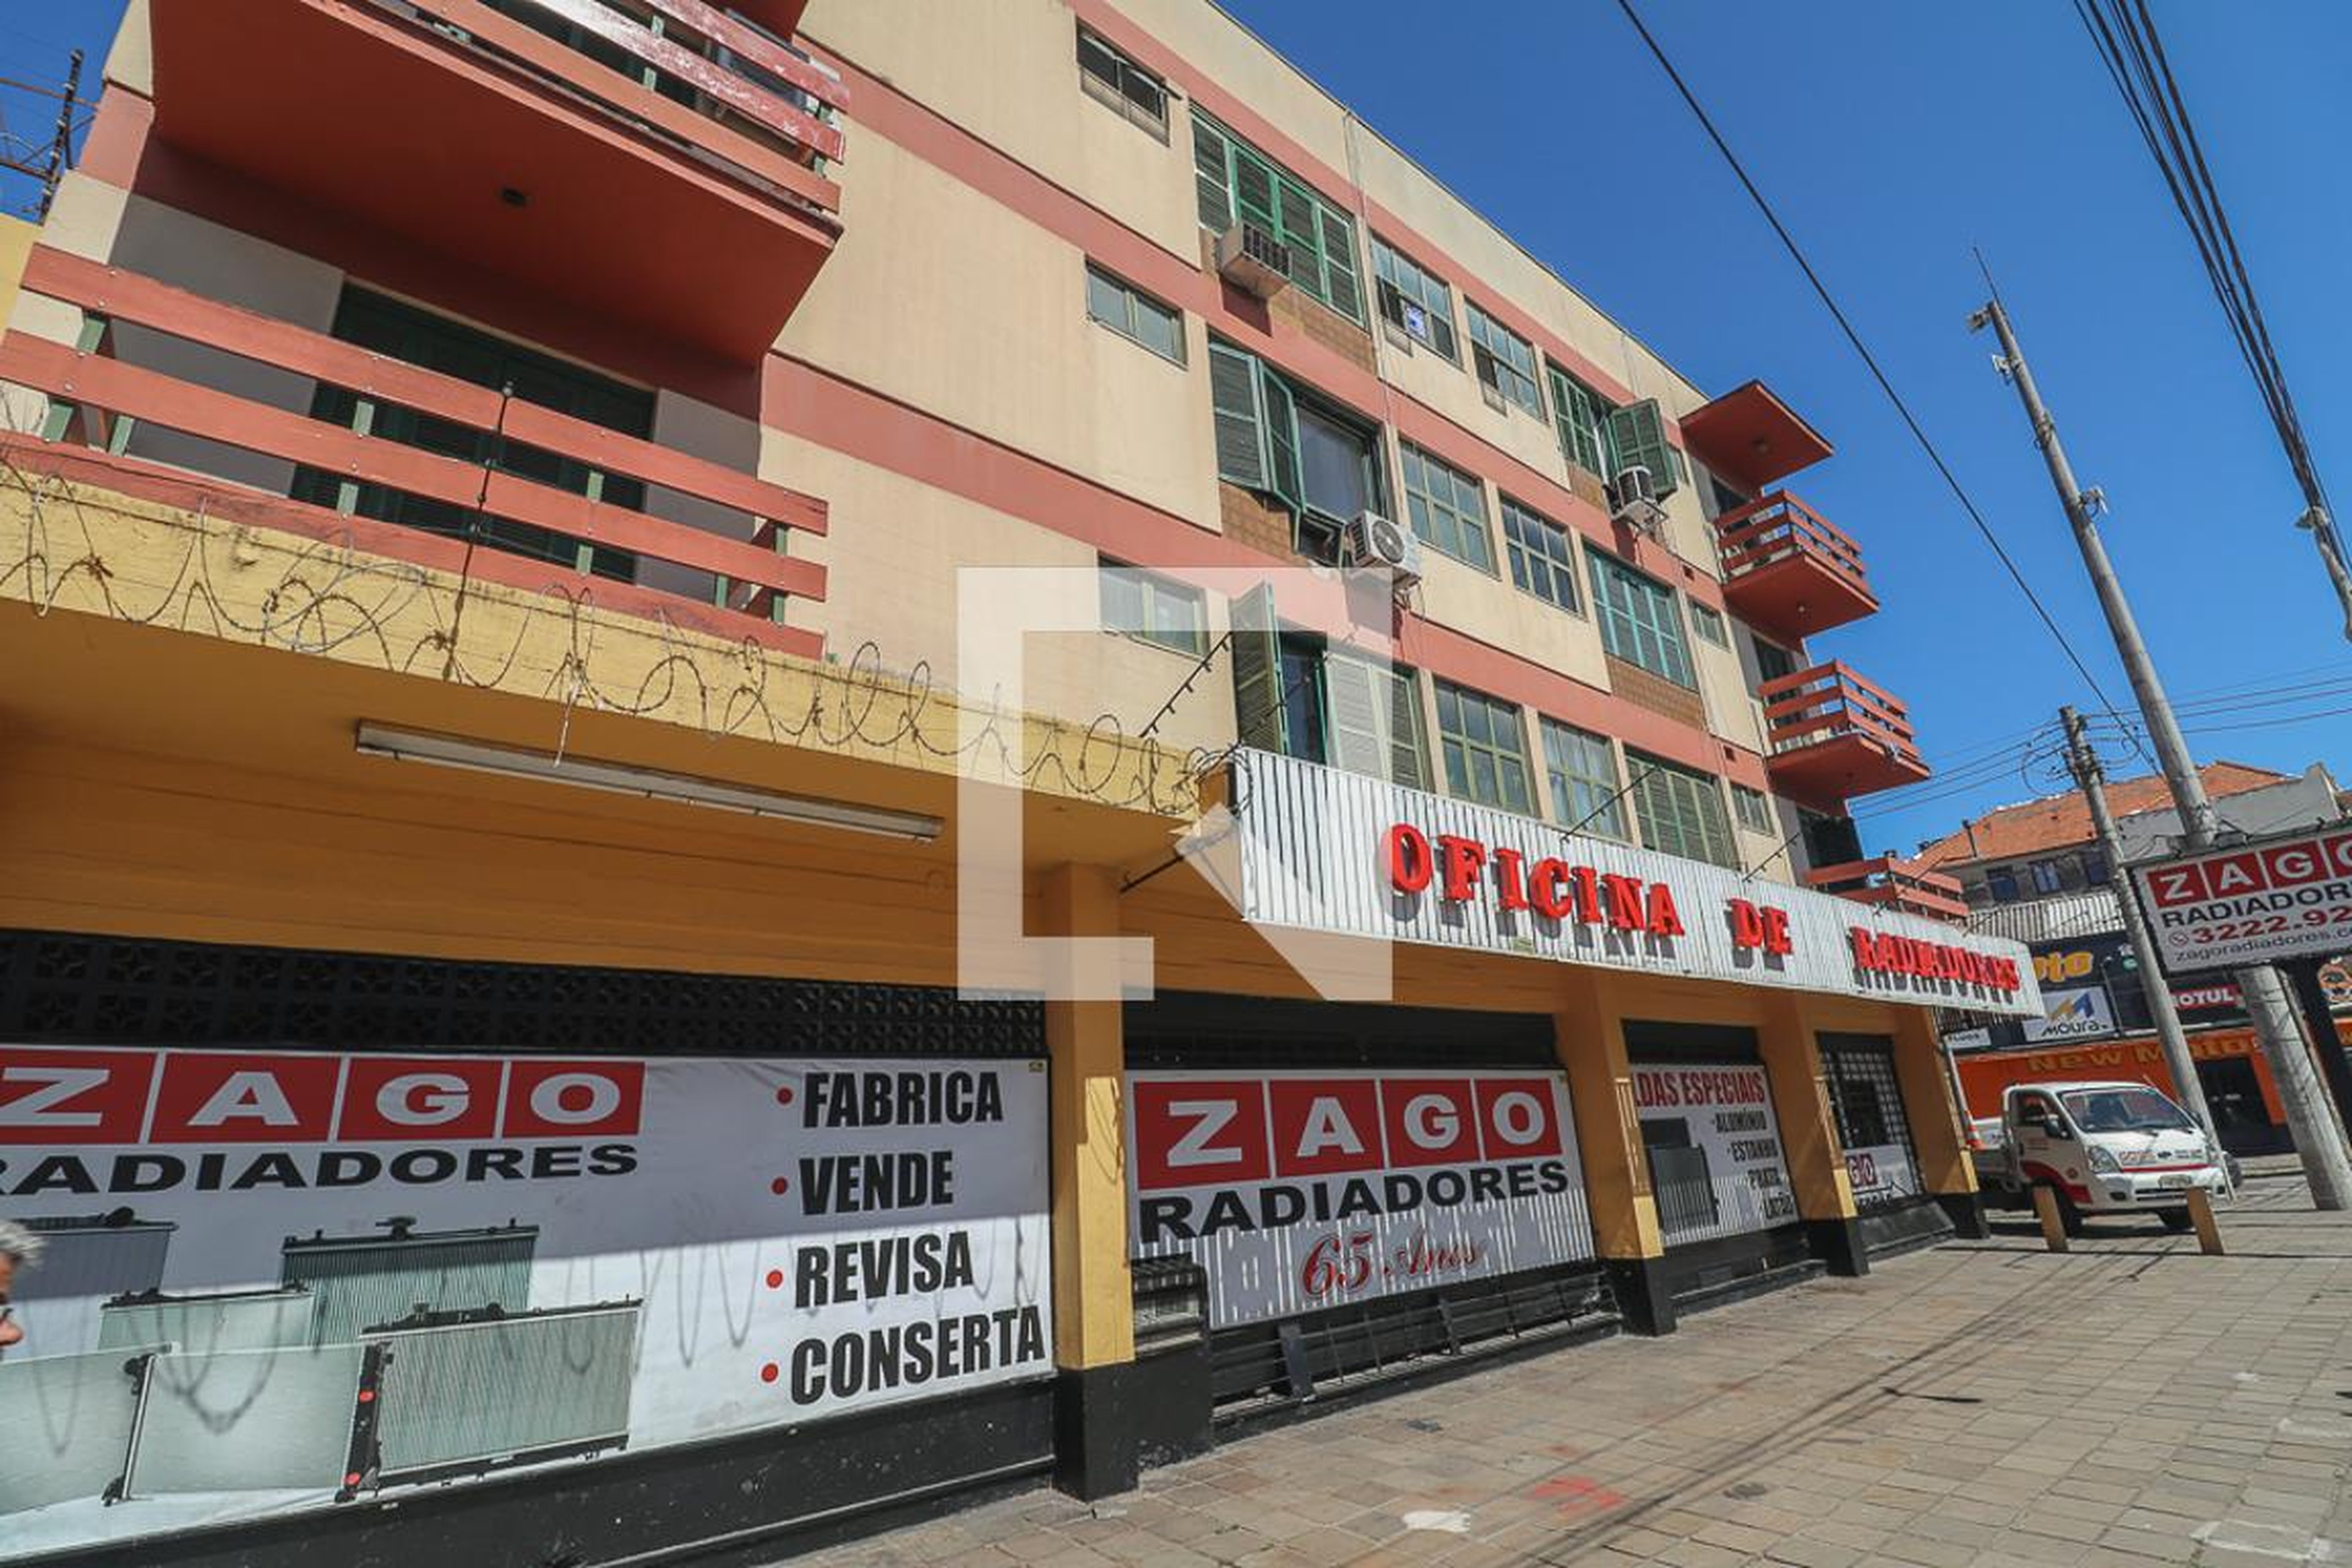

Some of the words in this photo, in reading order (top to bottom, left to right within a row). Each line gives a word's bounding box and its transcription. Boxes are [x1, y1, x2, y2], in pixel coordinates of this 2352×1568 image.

[1380, 823, 1686, 937] OFICINA
[1729, 897, 1792, 955] DE
[2163, 882, 2352, 927] RADIADOR
[2175, 926, 2352, 962] zagoradiadores.c
[2175, 989, 2234, 1008] OTUL
[0, 1067, 621, 1127] ZAGO
[803, 1072, 1003, 1128] FABRICA
[1634, 1072, 1679, 1107] DAS
[1679, 1071, 1765, 1105] ESPECIAIS
[1166, 1091, 1547, 1168] ZAGO
[0, 1144, 638, 1195] ADIADORES
[799, 1151, 954, 1215] VENDE
[1139, 1161, 1569, 1245] RADIADORES
[796, 1231, 974, 1309] REVISA
[1300, 1231, 1373, 1297] 65
[791, 1305, 1046, 1405] CONSERTA
